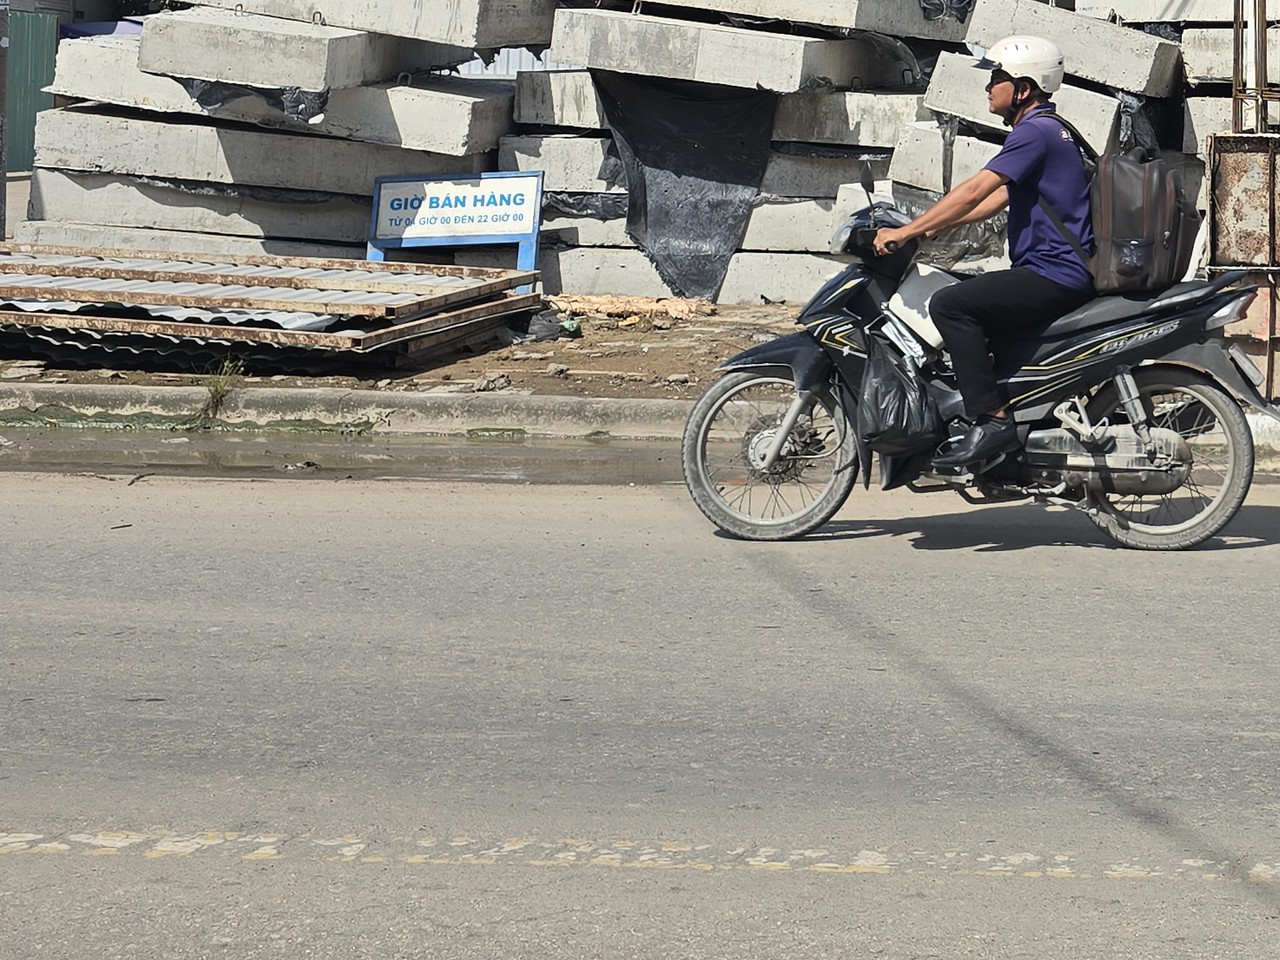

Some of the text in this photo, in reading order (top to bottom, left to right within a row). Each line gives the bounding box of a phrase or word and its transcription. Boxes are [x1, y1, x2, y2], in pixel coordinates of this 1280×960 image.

[389, 191, 525, 211] GIỜ BÁN HÀNG
[419, 216, 438, 225] GIỜ
[440, 217, 451, 225] 00
[477, 215, 488, 223] 22
[491, 213, 510, 222] GIỜ
[512, 214, 524, 222] 00
